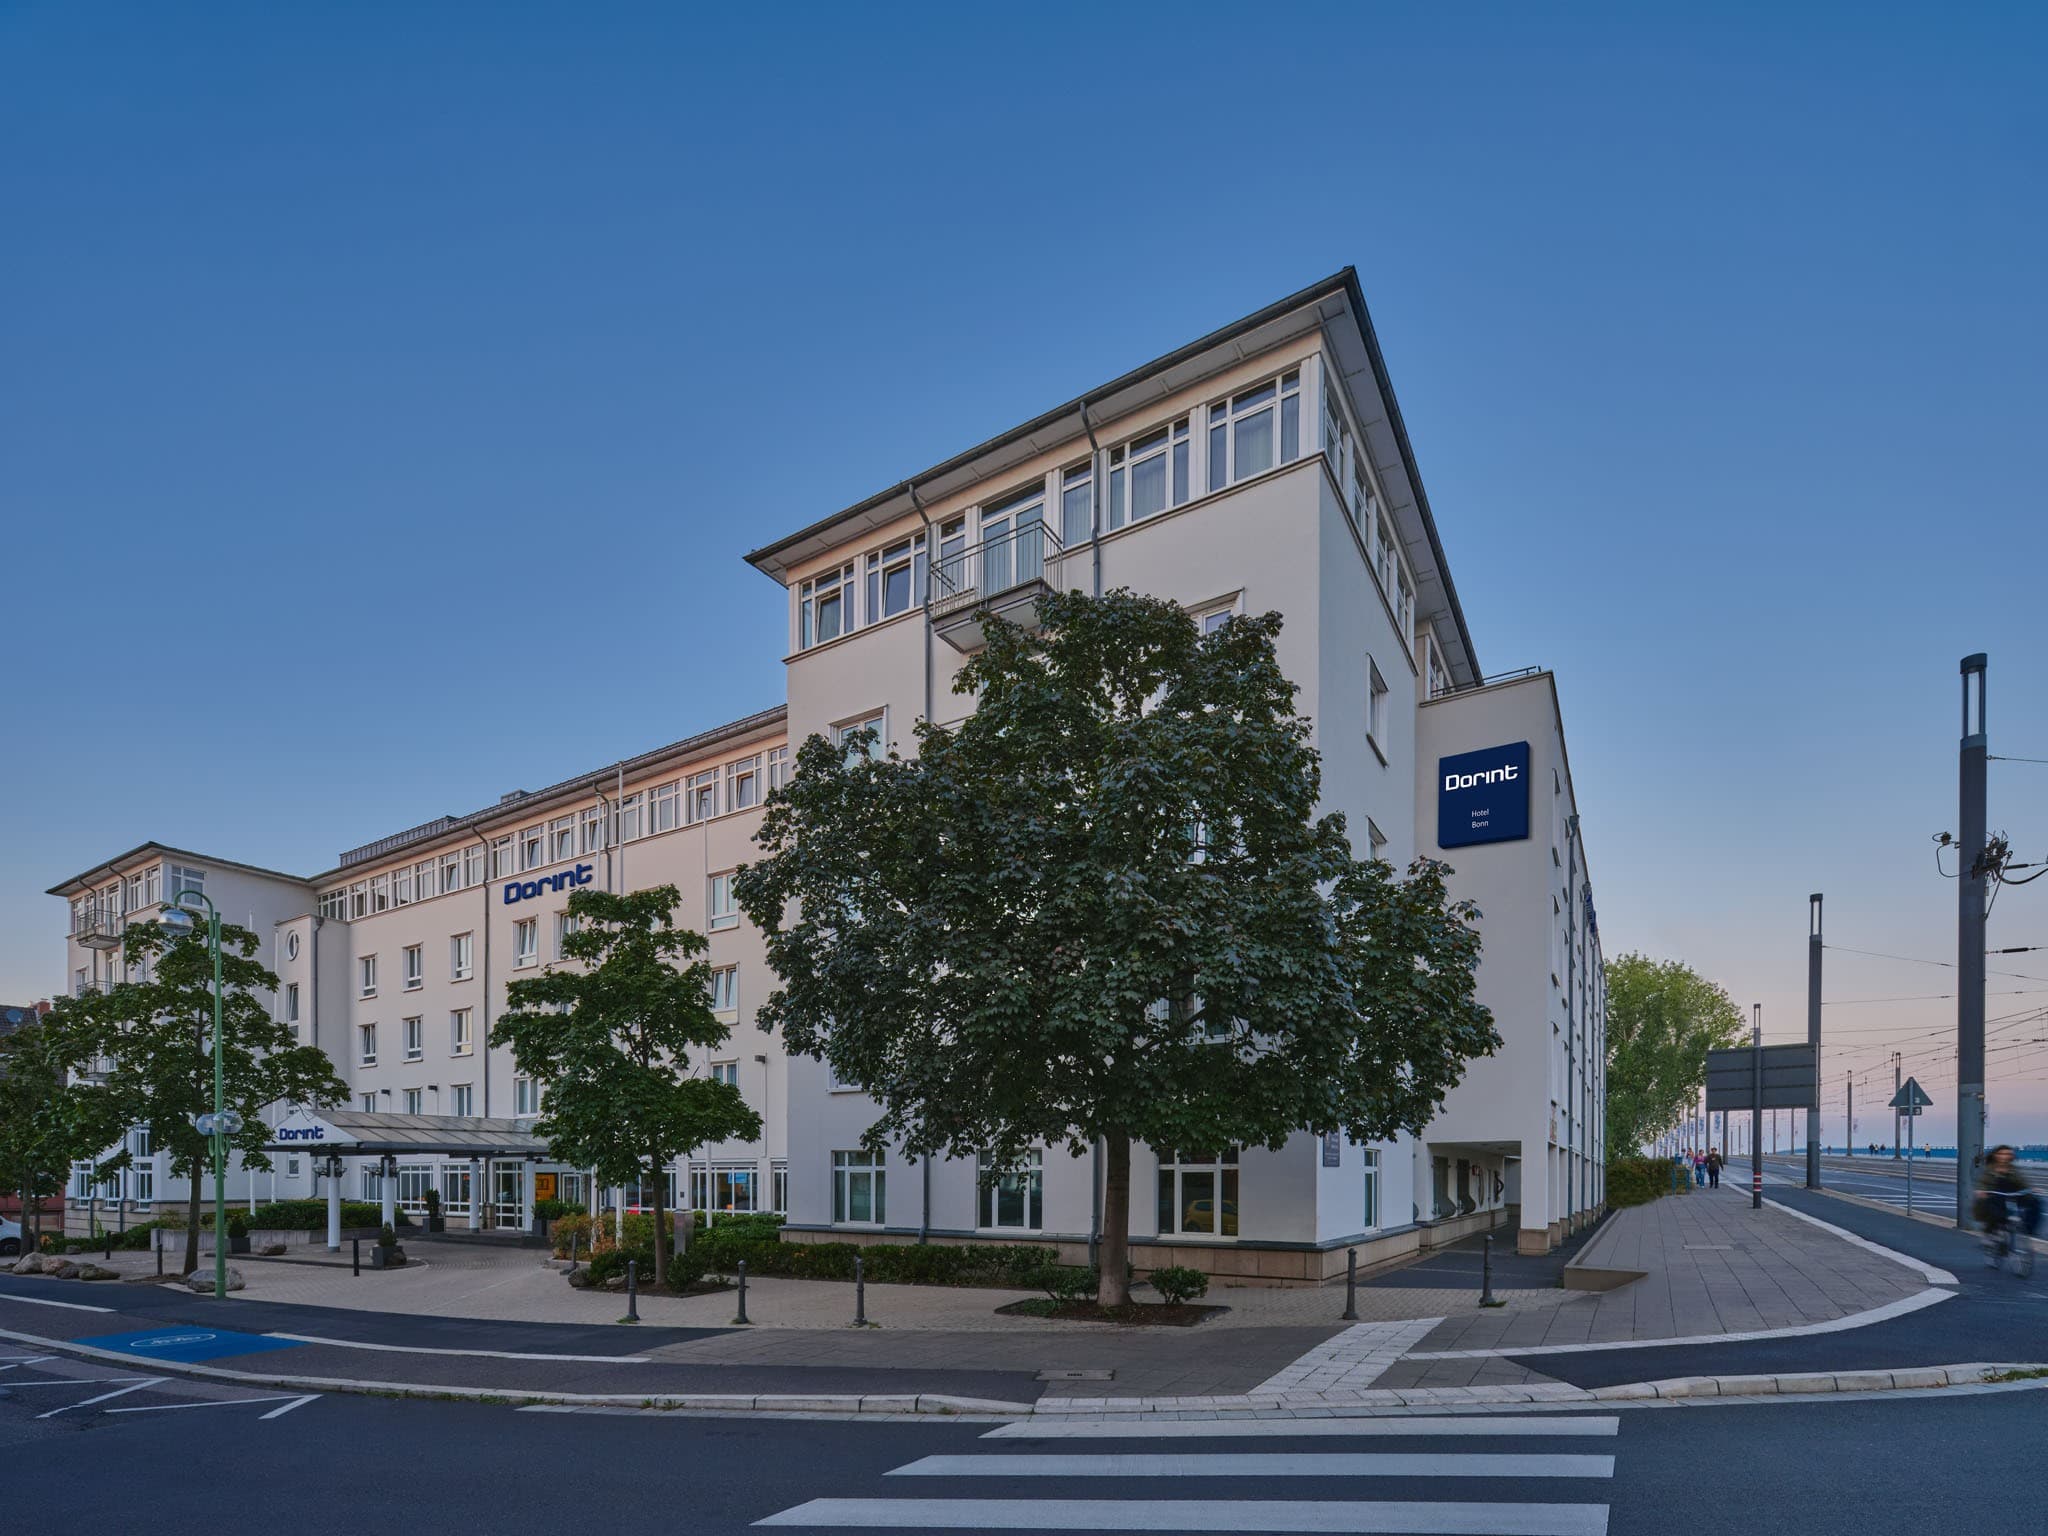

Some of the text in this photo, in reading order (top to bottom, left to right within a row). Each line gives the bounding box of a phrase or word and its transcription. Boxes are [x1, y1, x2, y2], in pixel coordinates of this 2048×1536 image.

[1445, 764, 1518, 791] Dorint
[1471, 808, 1490, 818] Hotel
[1471, 820, 1489, 829] Bonn
[504, 863, 593, 905] Dorint
[279, 1126, 324, 1140] Dorint
